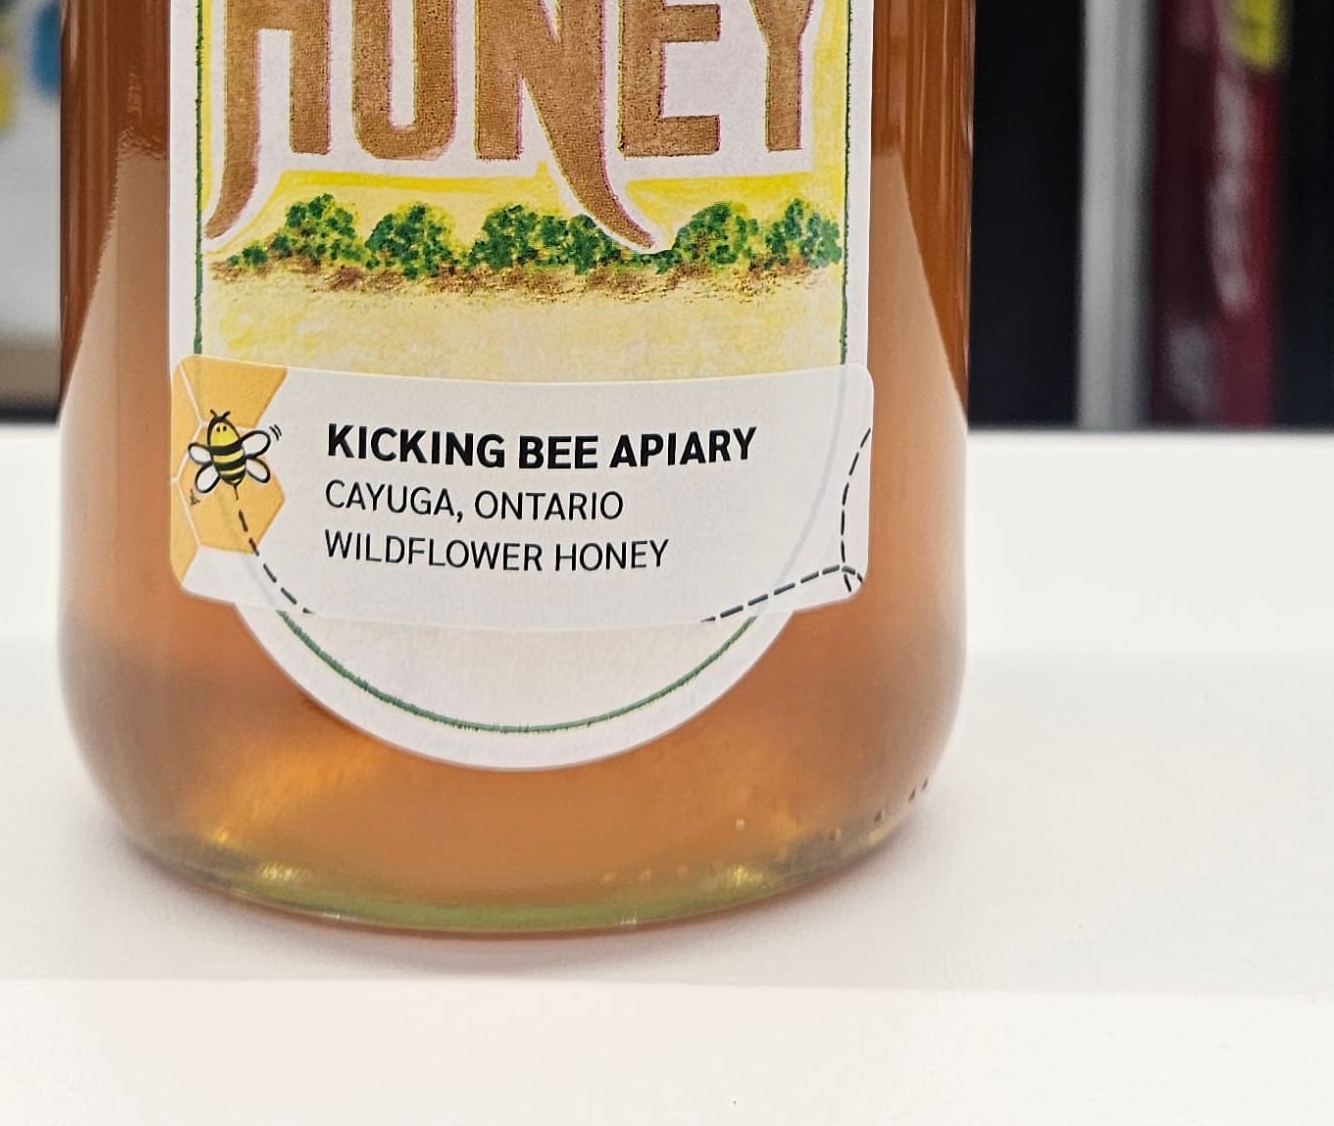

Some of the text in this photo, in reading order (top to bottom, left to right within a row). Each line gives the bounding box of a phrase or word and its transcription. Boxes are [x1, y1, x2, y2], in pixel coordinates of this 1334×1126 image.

[326, 422, 758, 470] KICKING BEE APIARY
[324, 478, 624, 523] CAYUGA, ONTARIO
[323, 528, 669, 572] WILDFLOWER HONEY
